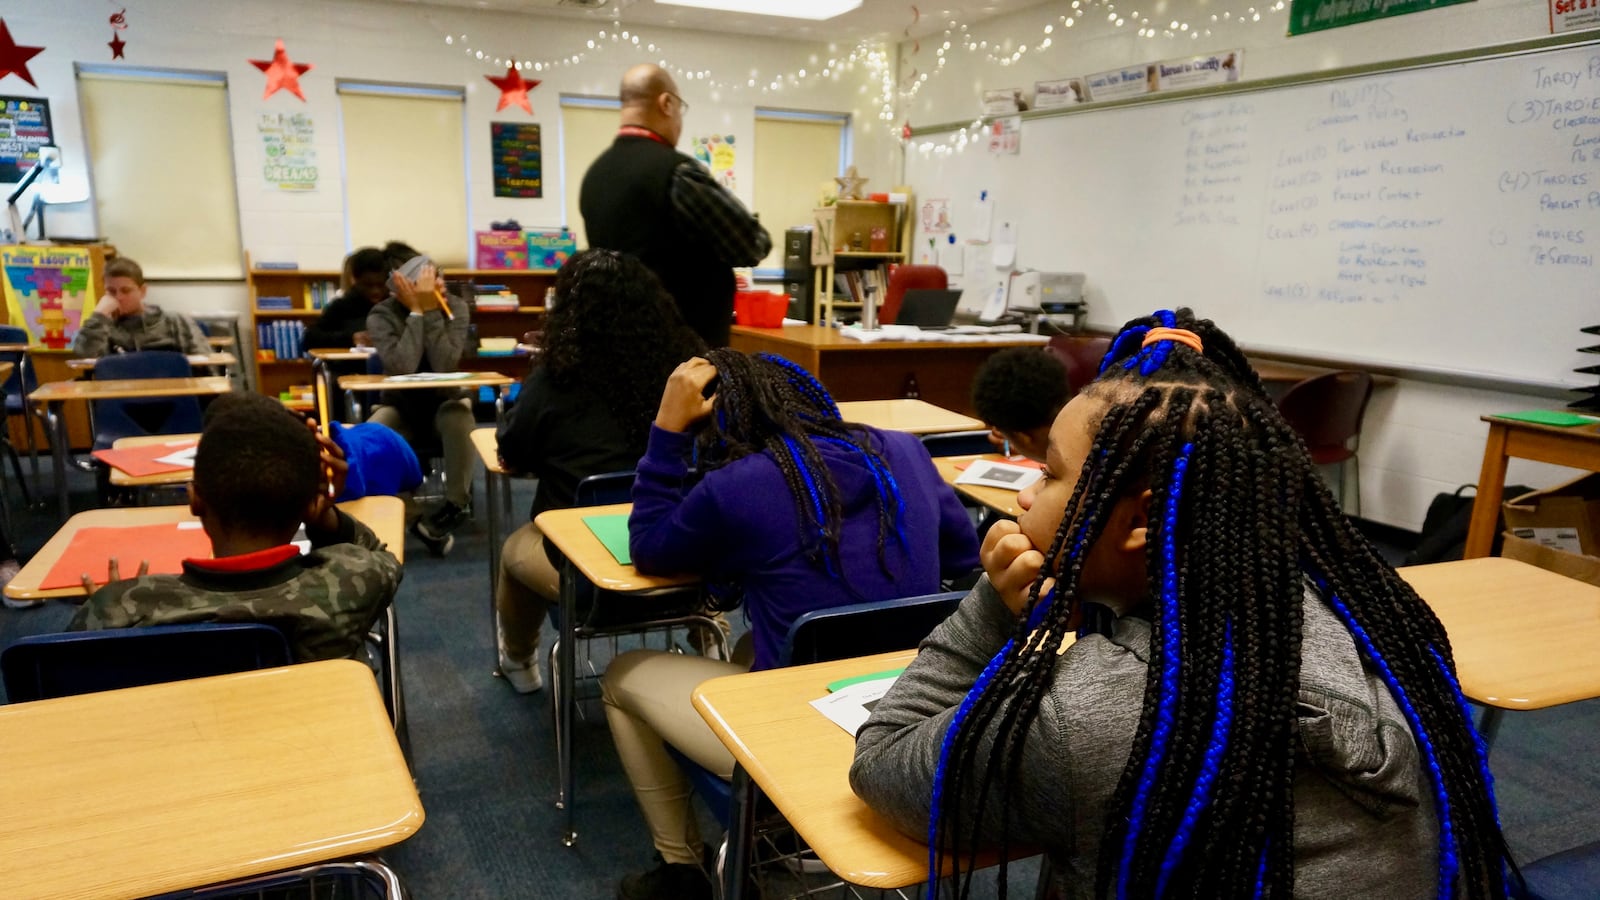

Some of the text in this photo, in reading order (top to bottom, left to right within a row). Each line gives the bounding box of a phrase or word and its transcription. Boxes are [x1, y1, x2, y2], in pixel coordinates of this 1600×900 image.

[1533, 66, 1581, 89] TARDY
[263, 165, 319, 182] DREAMS
[39, 256, 70, 265] ABOUT
